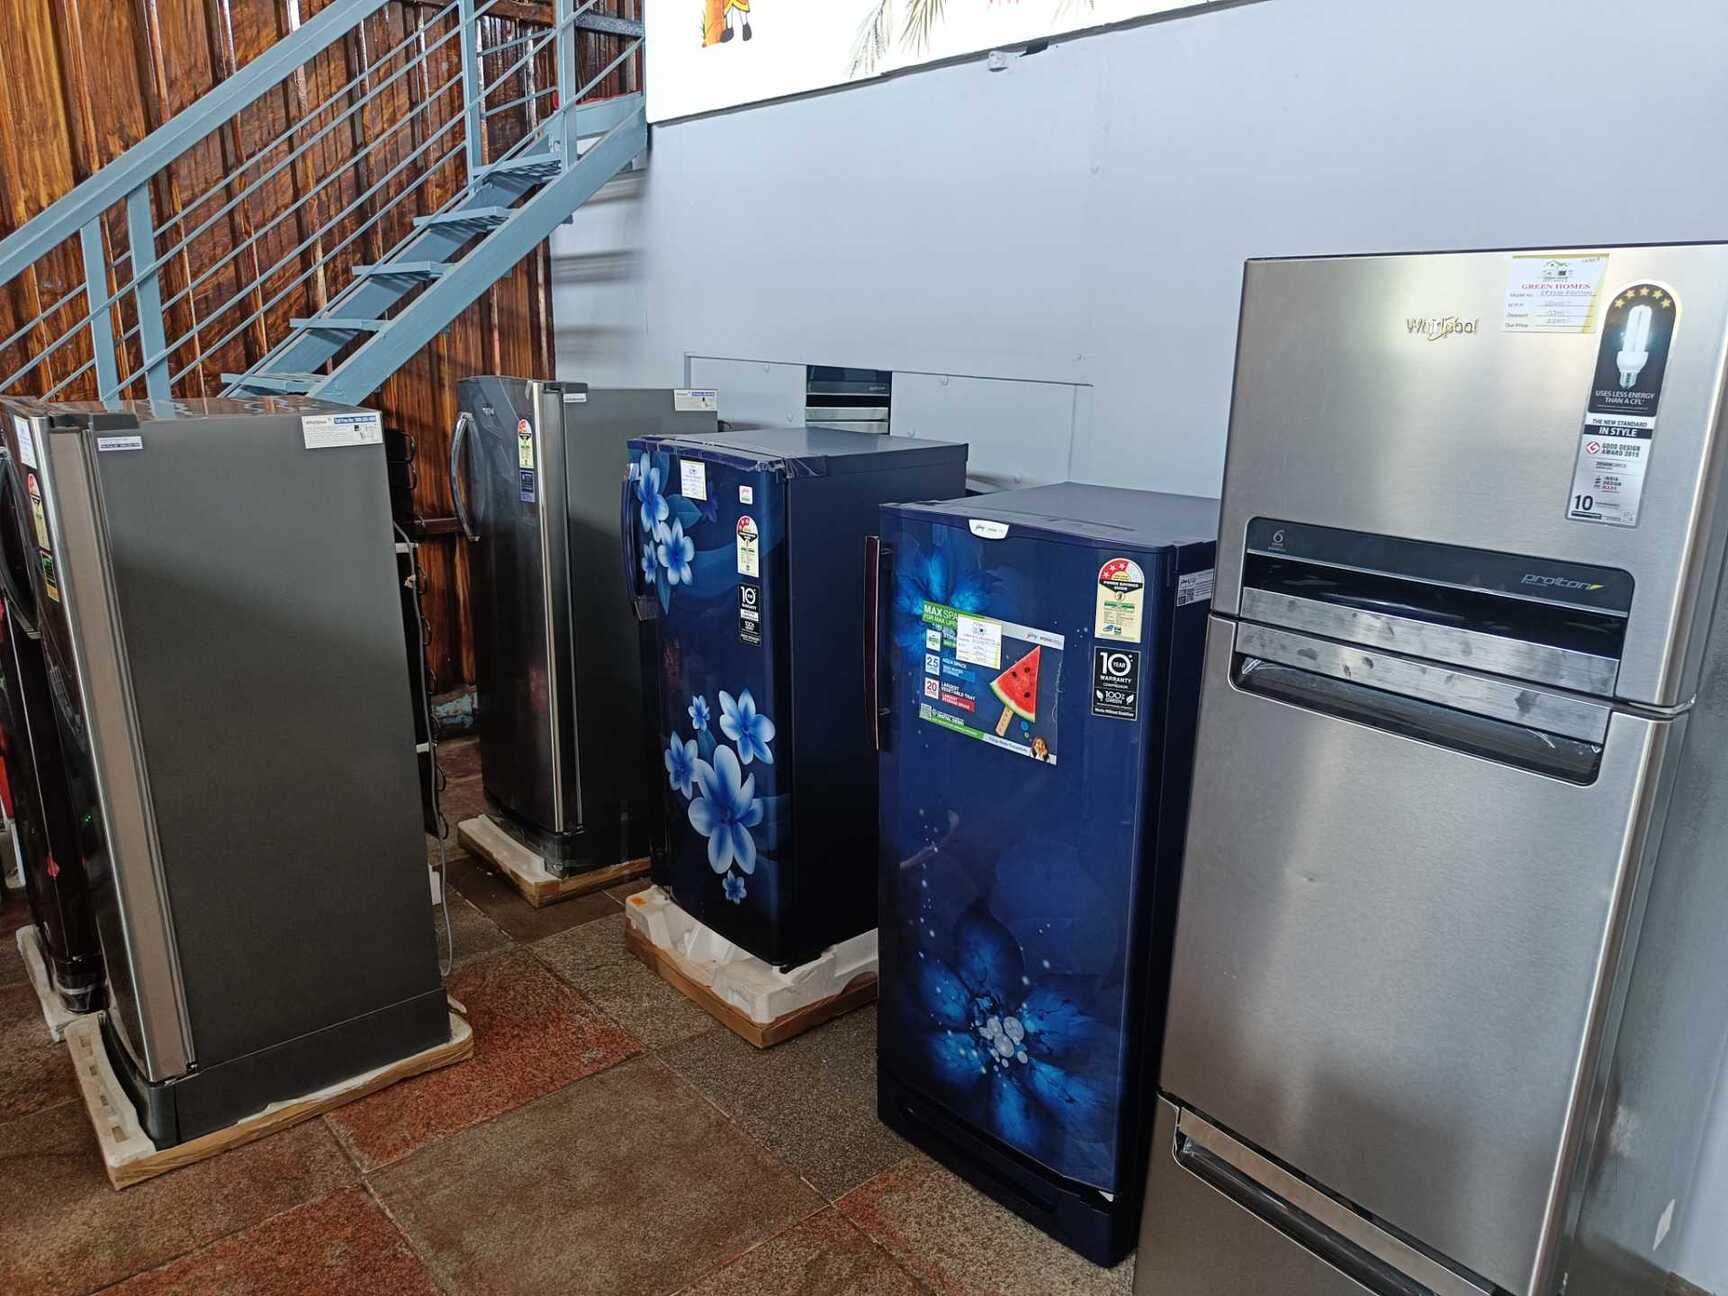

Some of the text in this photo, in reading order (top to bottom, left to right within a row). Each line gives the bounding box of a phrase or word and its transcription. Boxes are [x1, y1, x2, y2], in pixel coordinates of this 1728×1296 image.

[1595, 390, 1656, 400] USES LESS ENERGY
[1598, 427, 1638, 438] IN STYLE
[1575, 494, 1594, 511] 10
[924, 604, 958, 620] MAX SPA
[1100, 652, 1131, 677] 10
[1100, 675, 1132, 684] WARRANTY
[926, 680, 937, 692] 20
